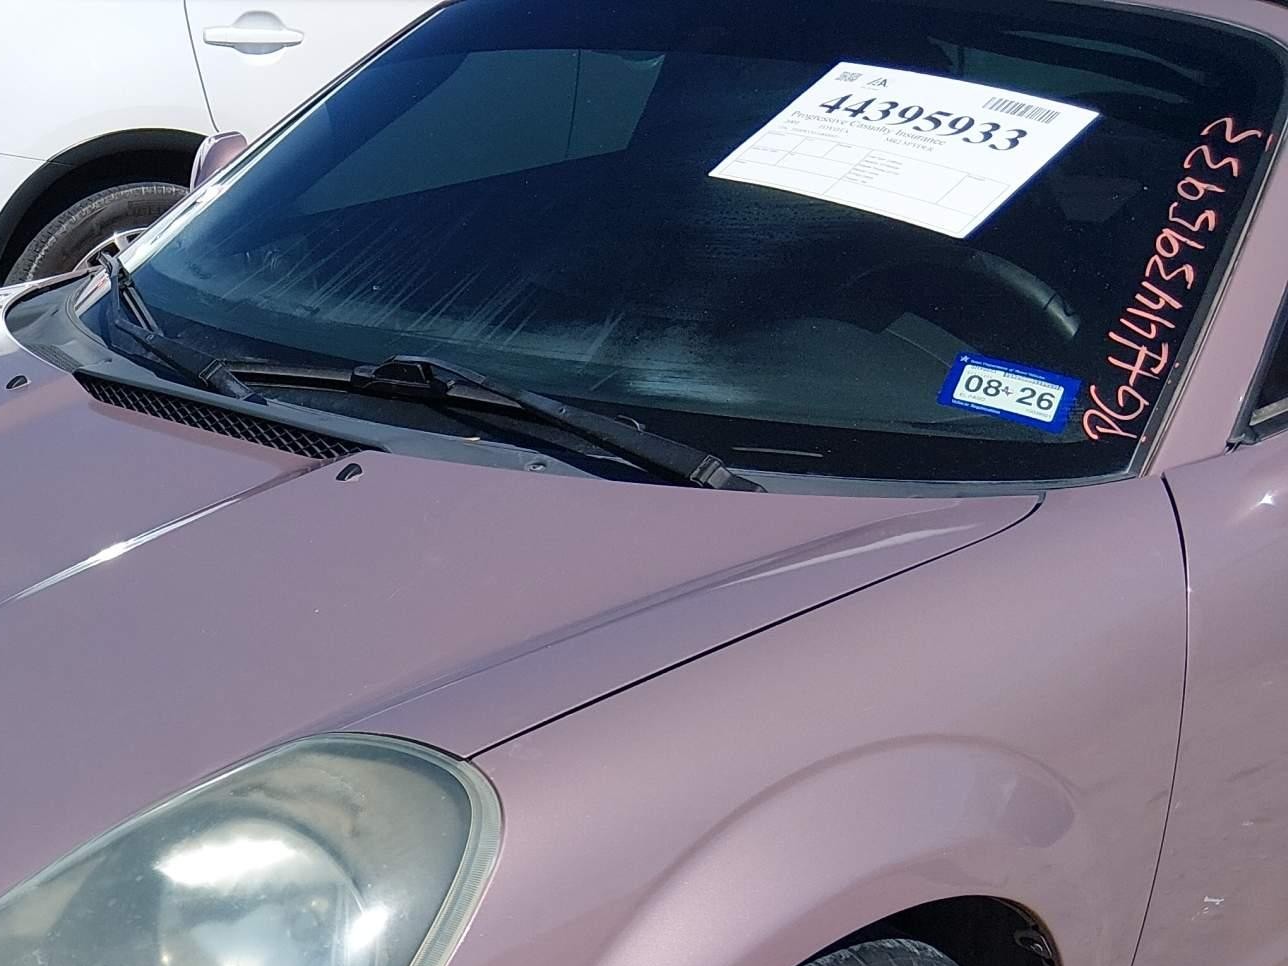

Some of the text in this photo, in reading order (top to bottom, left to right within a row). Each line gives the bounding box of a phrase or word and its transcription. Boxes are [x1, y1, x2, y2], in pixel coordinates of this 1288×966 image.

[791, 110, 848, 127] Progressive
[849, 118, 892, 138] Casualty
[895, 128, 947, 147] Insurance
[819, 93, 1028, 151] 44395933
[964, 374, 1003, 397] 08
[1015, 386, 1056, 411] 26
